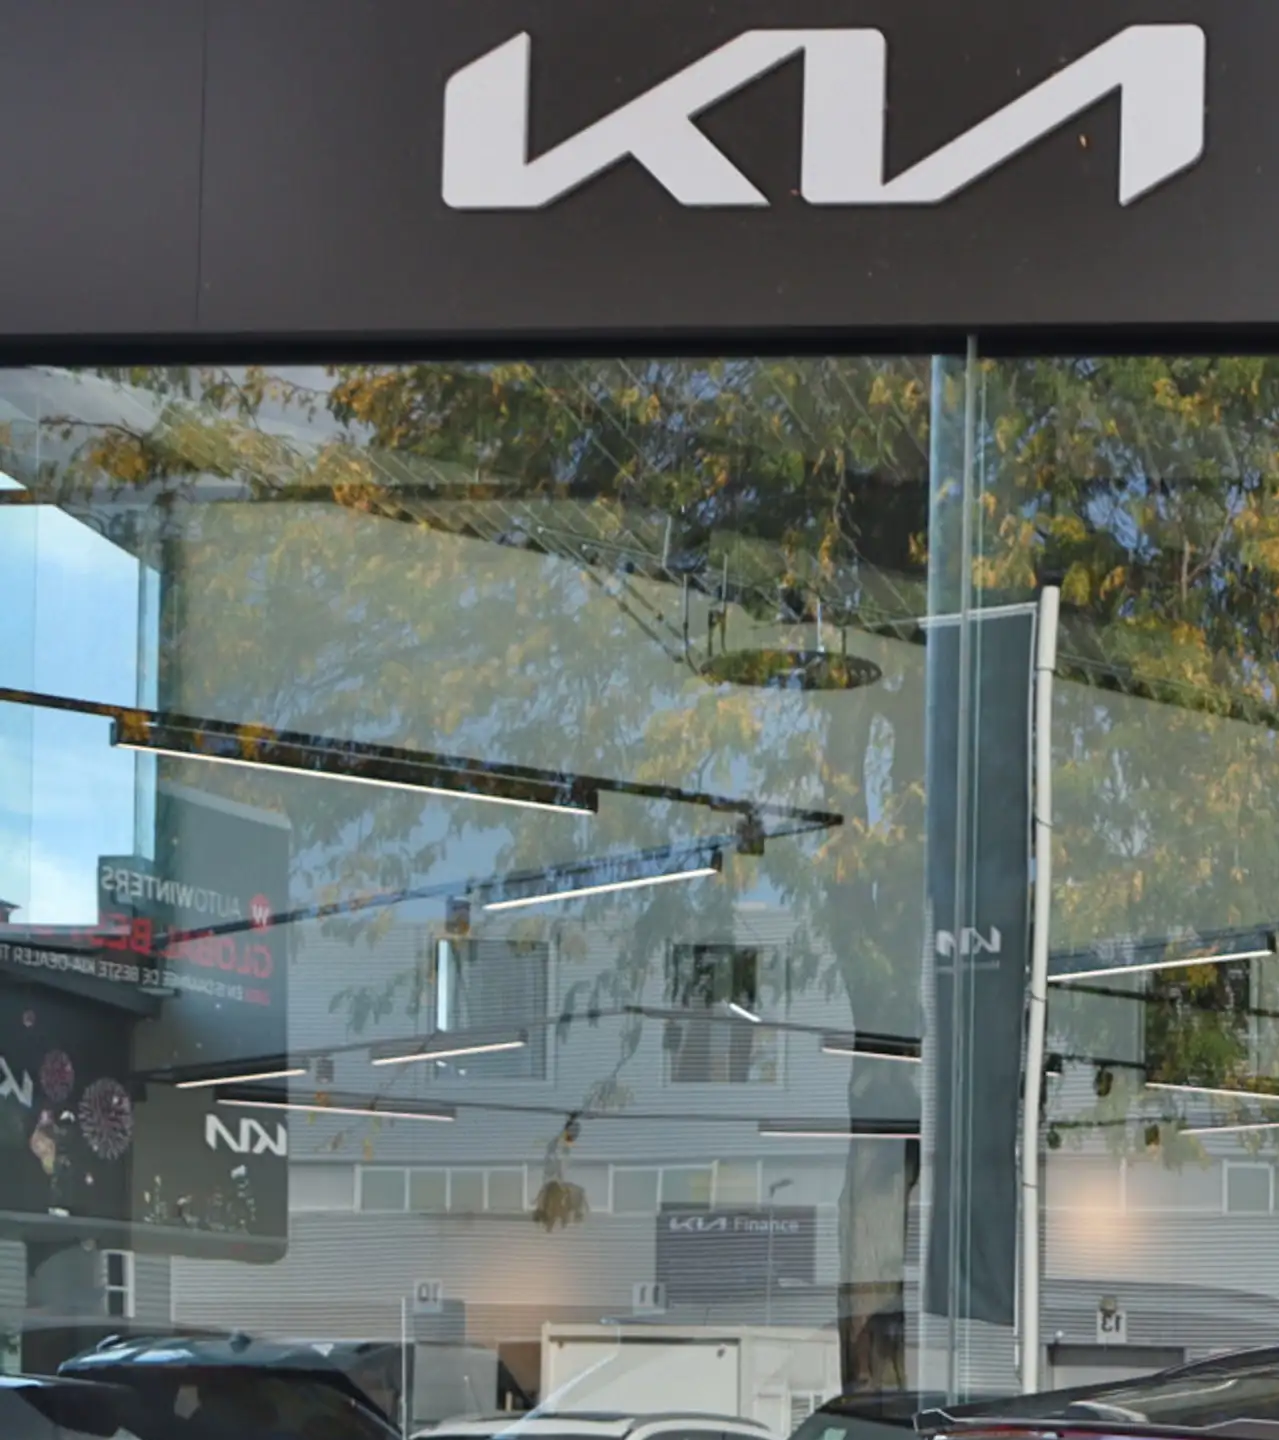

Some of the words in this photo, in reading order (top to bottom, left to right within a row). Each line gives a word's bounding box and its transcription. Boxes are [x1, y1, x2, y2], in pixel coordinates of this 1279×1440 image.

[442, 24, 1205, 209] KIA
[669, 1216, 727, 1232] KIA
[733, 1216, 799, 1233] Finance
